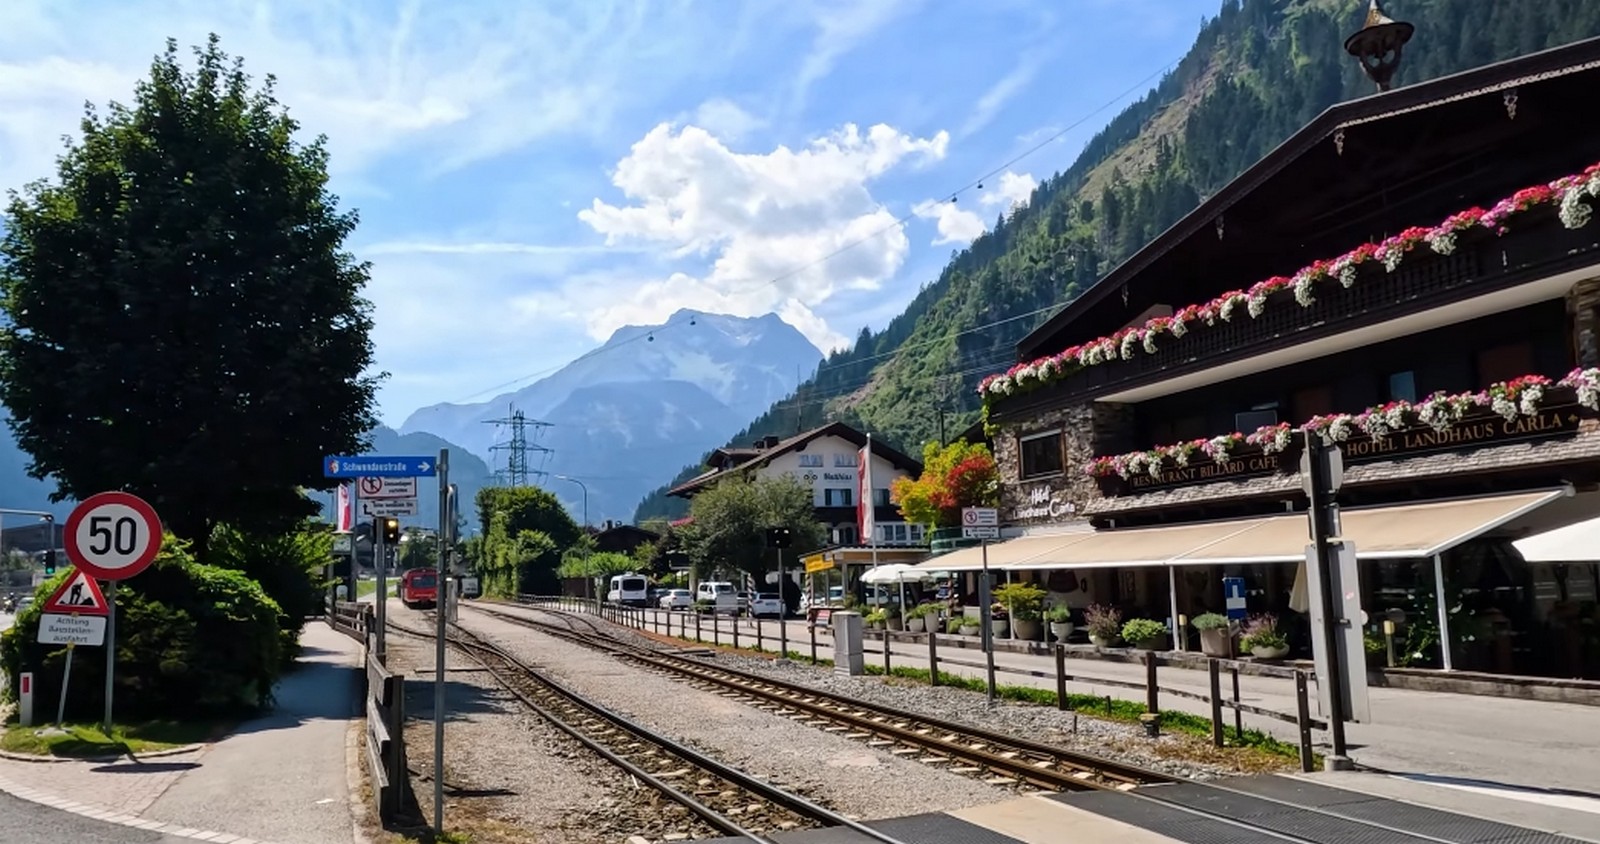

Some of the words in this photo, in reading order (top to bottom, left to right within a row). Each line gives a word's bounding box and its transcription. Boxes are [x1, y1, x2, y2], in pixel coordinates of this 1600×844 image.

[1347, 436, 1398, 456] HOTEL
[1404, 422, 1494, 449] LANDHAUS
[1502, 413, 1563, 435] CARLA
[1201, 460, 1245, 478] BILLARD
[89, 516, 137, 555] 50
